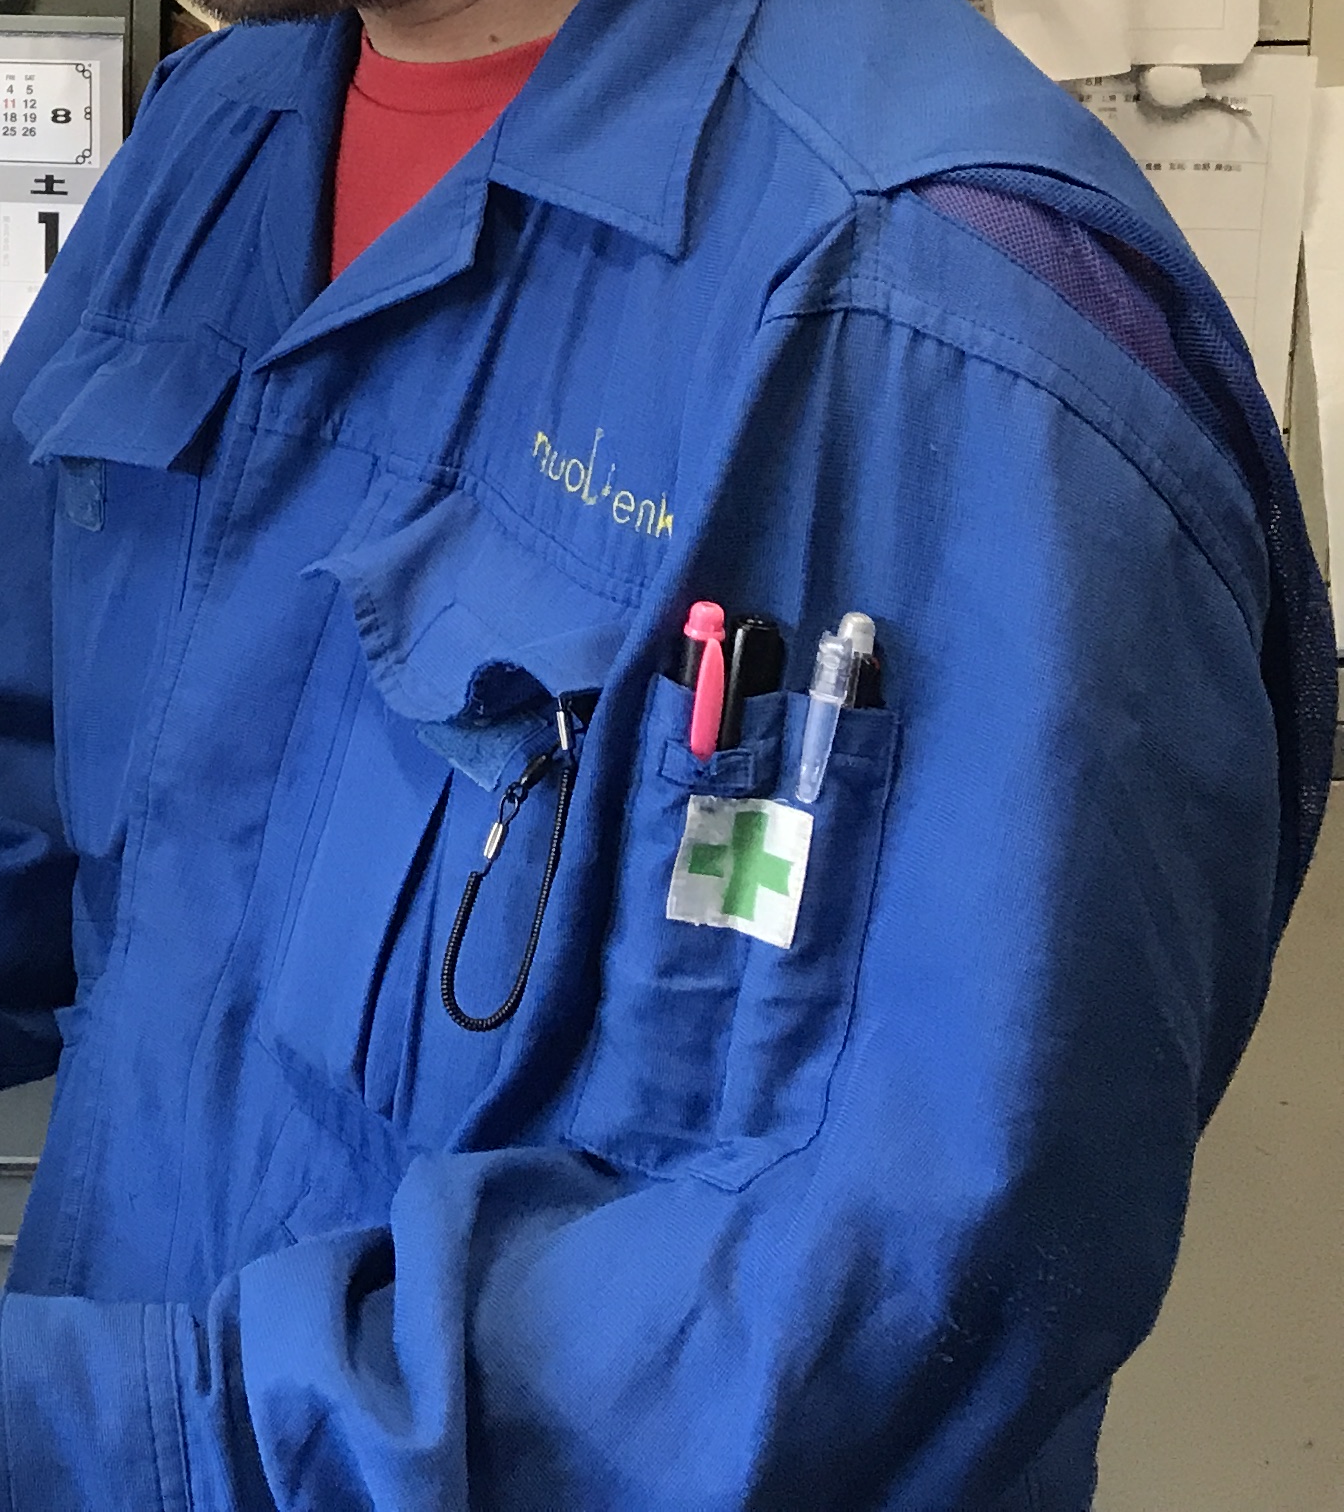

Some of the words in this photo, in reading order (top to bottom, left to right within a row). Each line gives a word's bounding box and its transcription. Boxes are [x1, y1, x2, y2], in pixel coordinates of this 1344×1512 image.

[50, 107, 72, 124] 8
[30, 174, 68, 195] 土
[38, 212, 59, 273] 1
